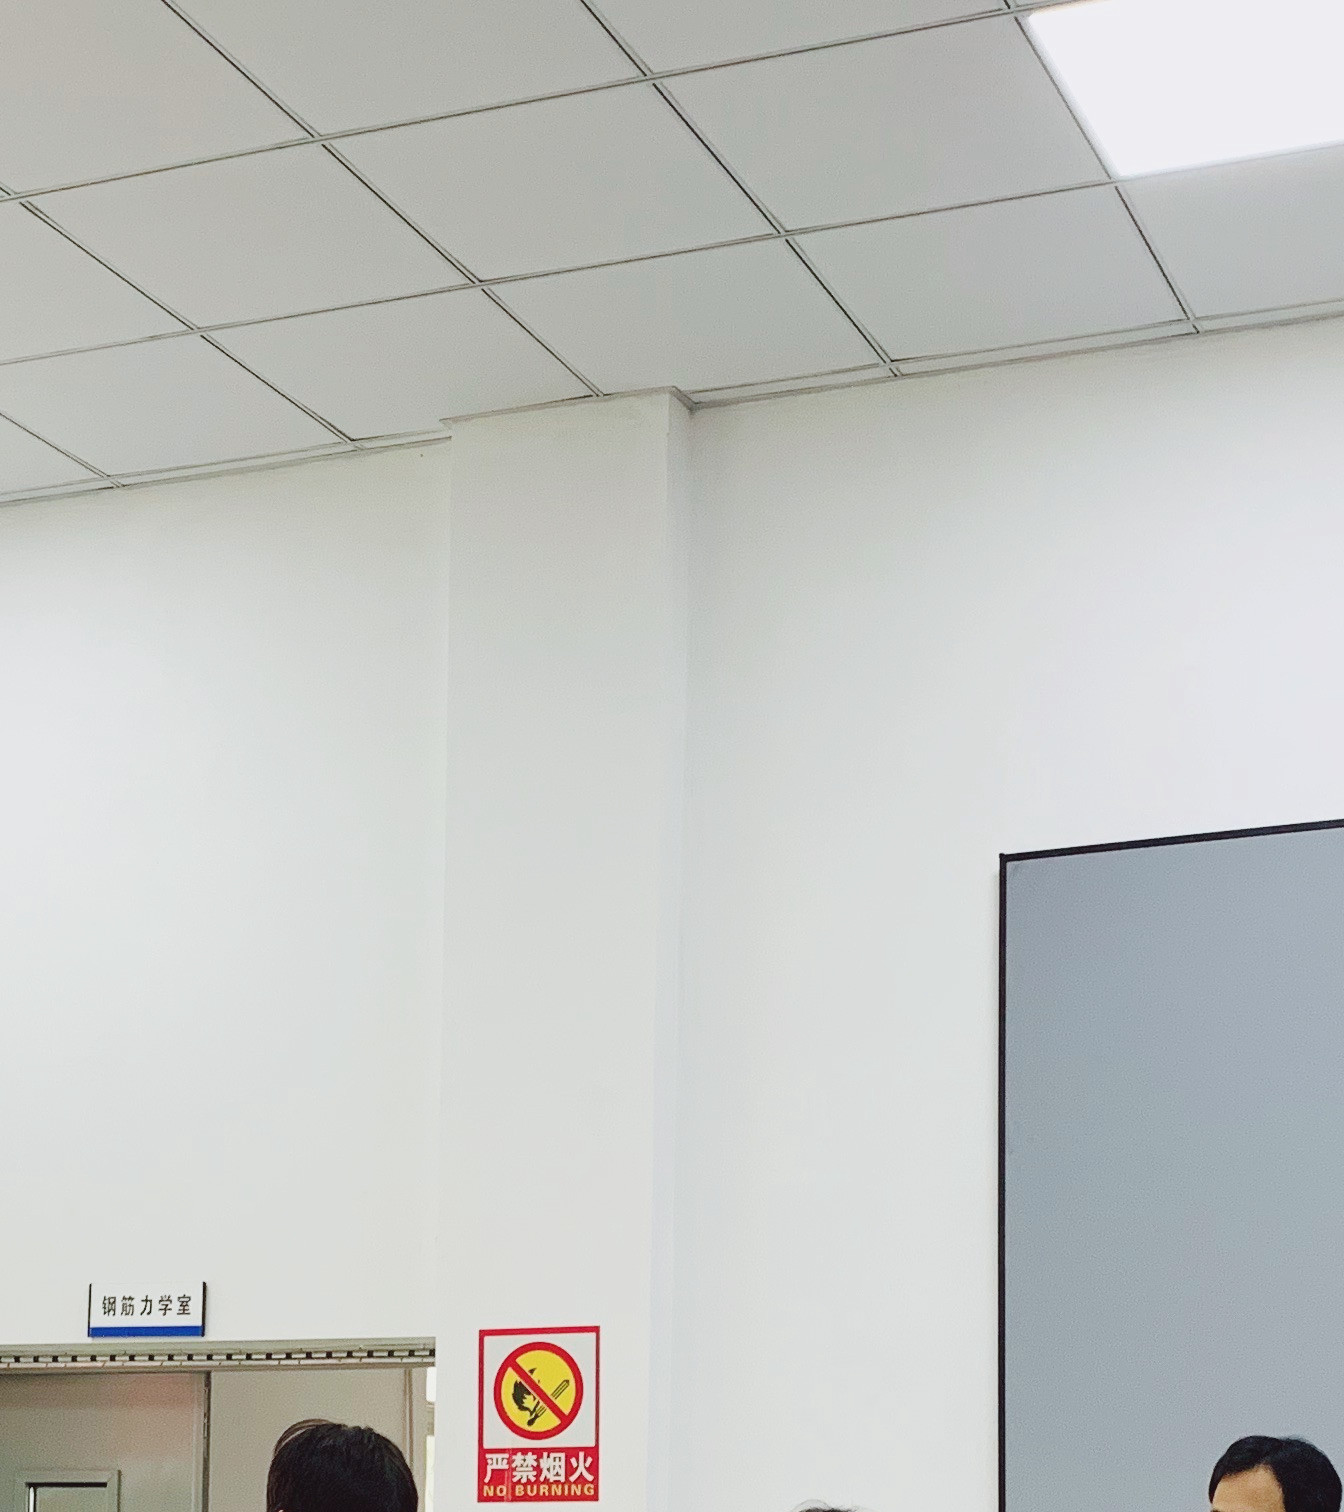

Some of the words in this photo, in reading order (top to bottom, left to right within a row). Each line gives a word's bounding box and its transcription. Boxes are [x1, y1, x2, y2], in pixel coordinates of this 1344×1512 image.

[102, 1294, 192, 1316] 钢筋力学室
[484, 1451, 595, 1483] 严禁烟火
[483, 1485, 506, 1497] NO
[515, 1484, 595, 1497] BURNING
